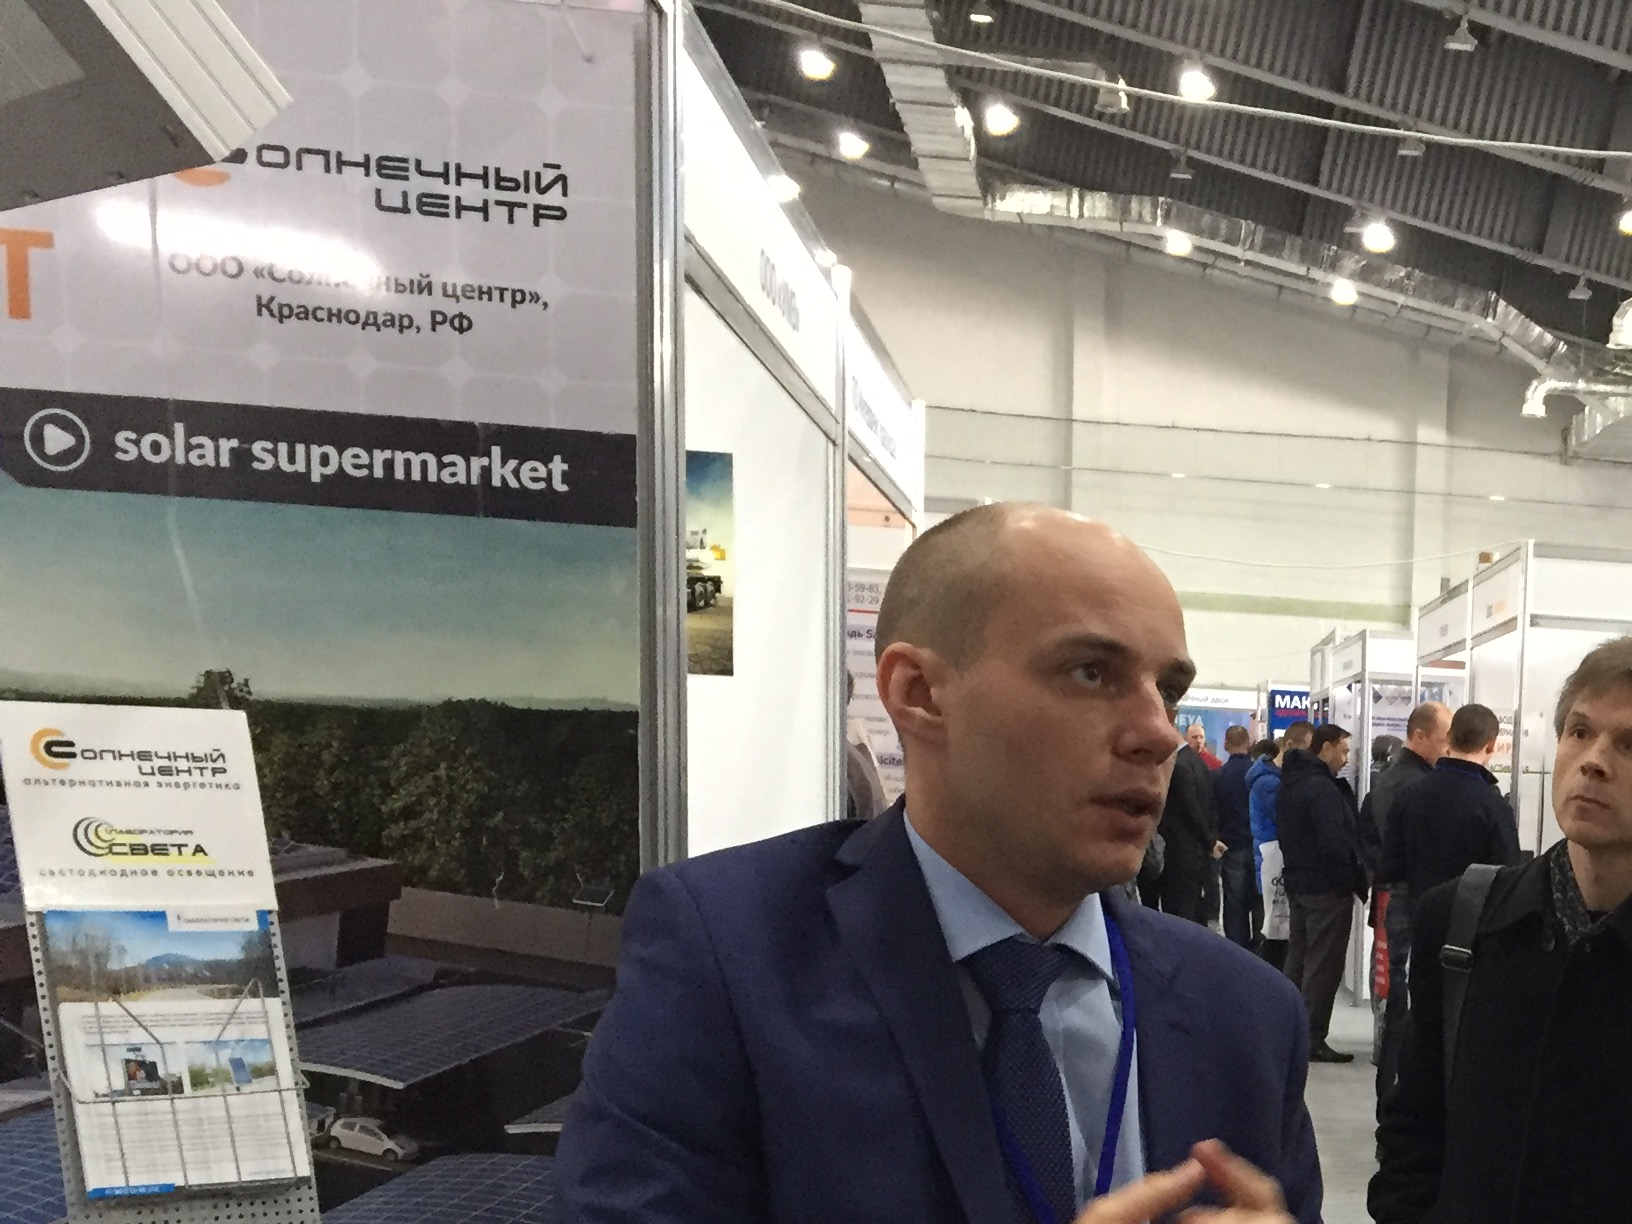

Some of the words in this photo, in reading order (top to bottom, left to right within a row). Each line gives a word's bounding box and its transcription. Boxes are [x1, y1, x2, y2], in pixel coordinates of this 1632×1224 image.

[222, 143, 569, 198] ОЛНЕЧНЫЙ
[374, 188, 569, 228] ЦЕНТР
[167, 252, 245, 281] ООО
[441, 282, 549, 311] центр»,
[255, 293, 422, 335] Краснодар,
[429, 309, 474, 335] РФ
[114, 421, 240, 468] solar
[250, 437, 570, 494] supermarket
[43, 739, 227, 764] СОЛНЕЧНЫЙ
[137, 764, 228, 777] ЦЕНТР
[107, 842, 209, 857] СВЕТА
[38, 867, 159, 878] светодиодное
[166, 868, 255, 879] освещение
